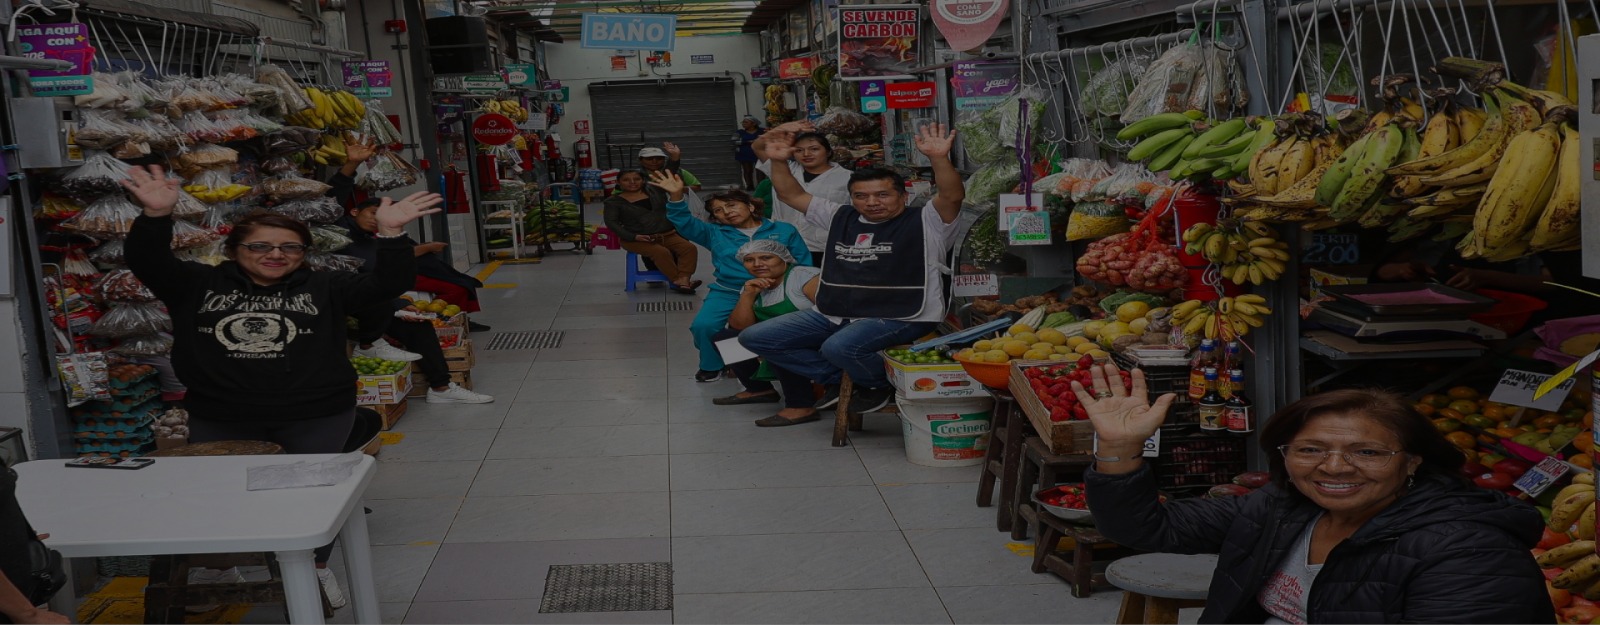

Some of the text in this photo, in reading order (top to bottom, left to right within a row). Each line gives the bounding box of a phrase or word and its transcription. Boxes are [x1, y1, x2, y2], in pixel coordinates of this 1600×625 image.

[843, 10, 916, 22] SE VENDE
[17, 28, 43, 36] AGA
[592, 18, 665, 42] BAÑO
[47, 38, 75, 46] CON
[983, 79, 1010, 92] yape
[474, 127, 513, 135] Redondos
[1502, 370, 1574, 390] MANDAA
[940, 422, 989, 435] Cocinero
